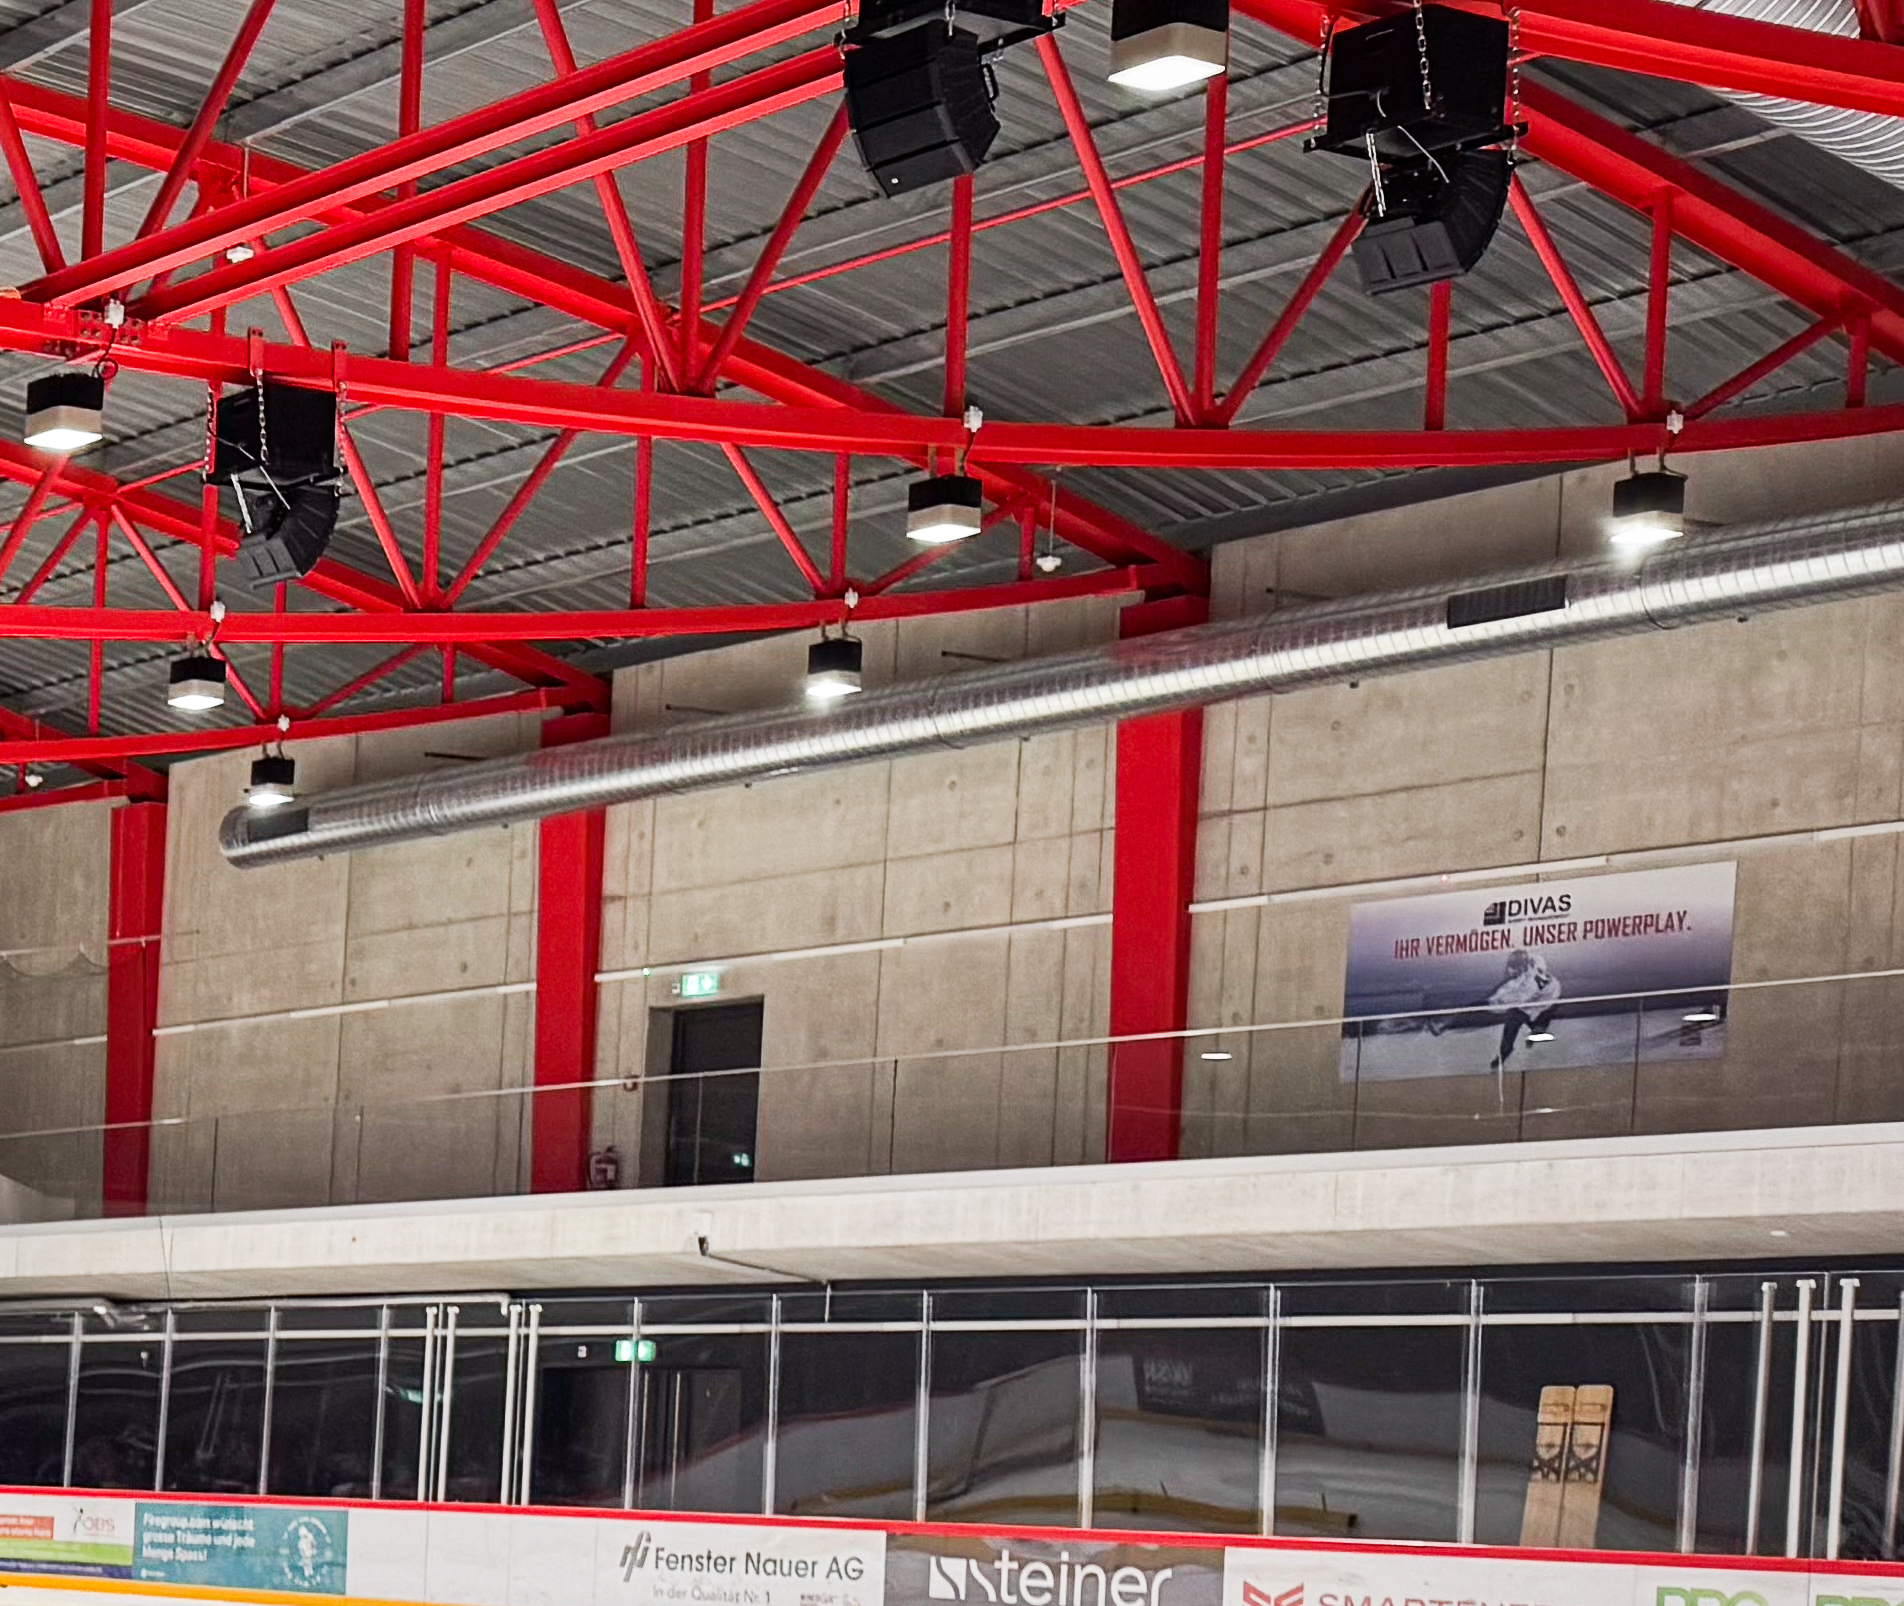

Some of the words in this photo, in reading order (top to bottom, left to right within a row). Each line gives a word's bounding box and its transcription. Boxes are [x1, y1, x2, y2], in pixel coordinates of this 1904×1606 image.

[1508, 894, 1572, 917] DIVAS
[1394, 938, 1420, 959] IHR
[1426, 929, 1514, 956] VERMÖGEN.
[1523, 922, 1577, 947] UNSER
[1583, 910, 1692, 940] POWERPLAY.
[655, 1548, 736, 1574] Fenster
[745, 1552, 818, 1578] Nauer
[826, 1556, 864, 1580] AG
[667, 1586, 687, 1599] der
[765, 1591, 771, 1604] 1
